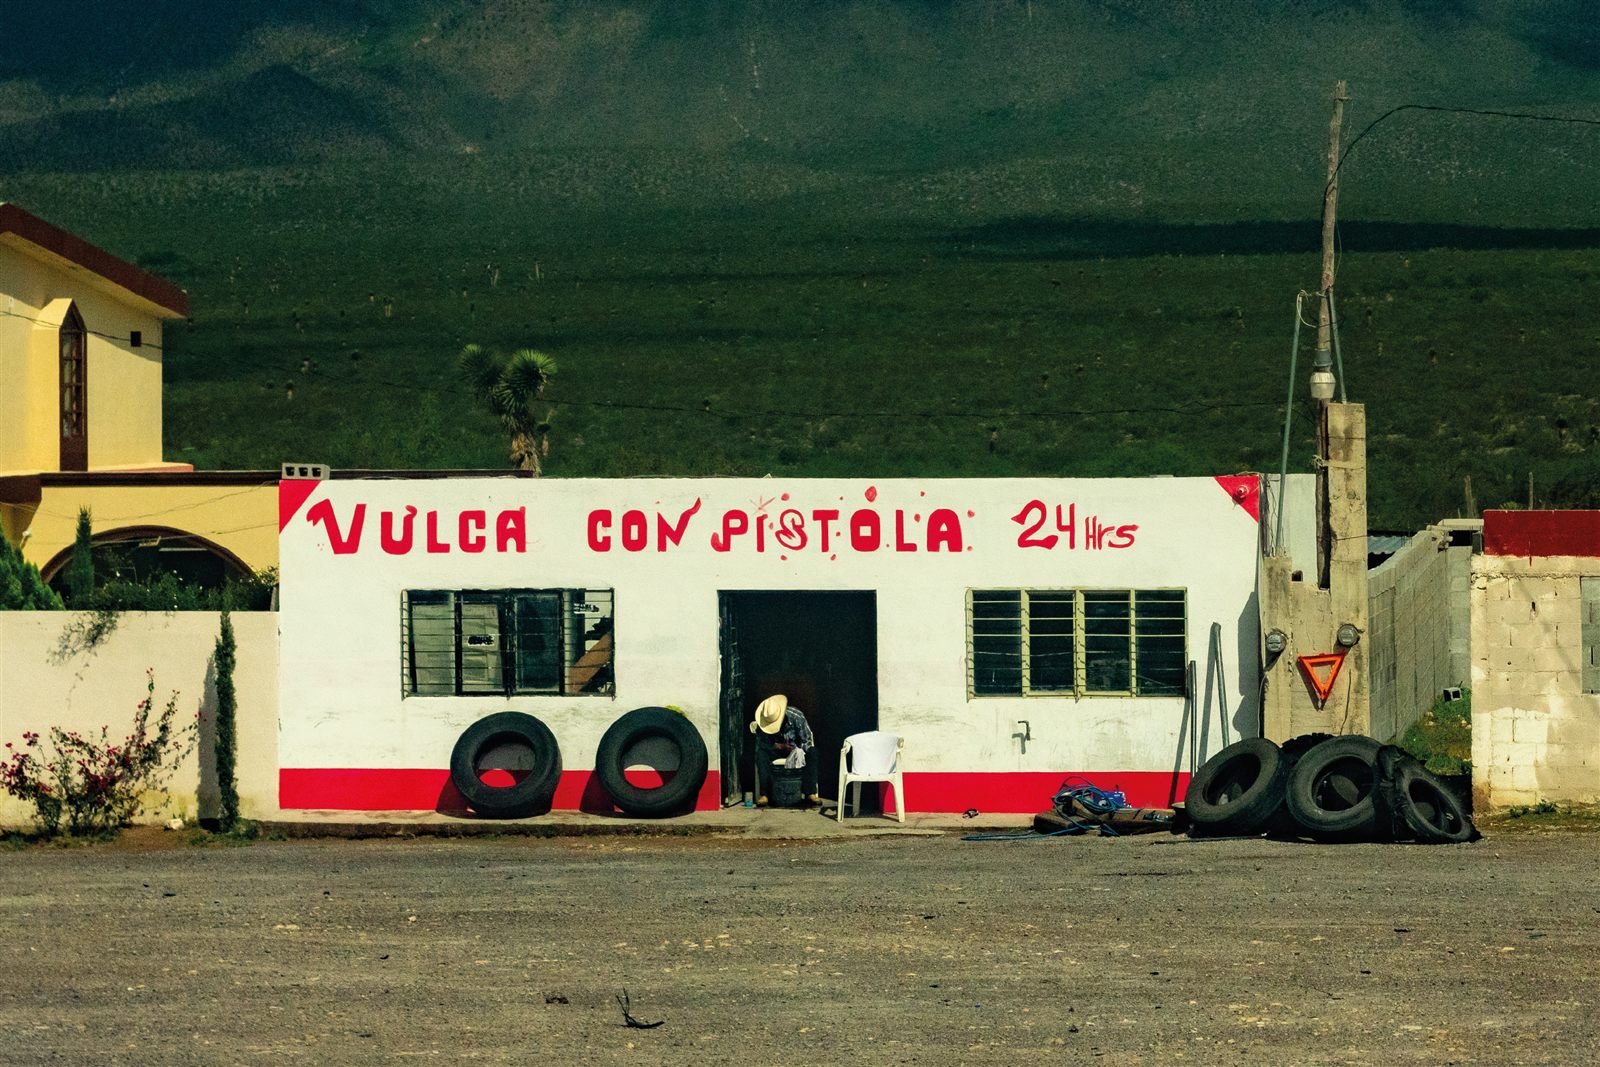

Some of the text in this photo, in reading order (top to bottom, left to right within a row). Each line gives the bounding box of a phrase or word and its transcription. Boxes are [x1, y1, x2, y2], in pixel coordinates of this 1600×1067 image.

[306, 498, 1138, 556] VULCA CON PISTOLA 24 Hrs
